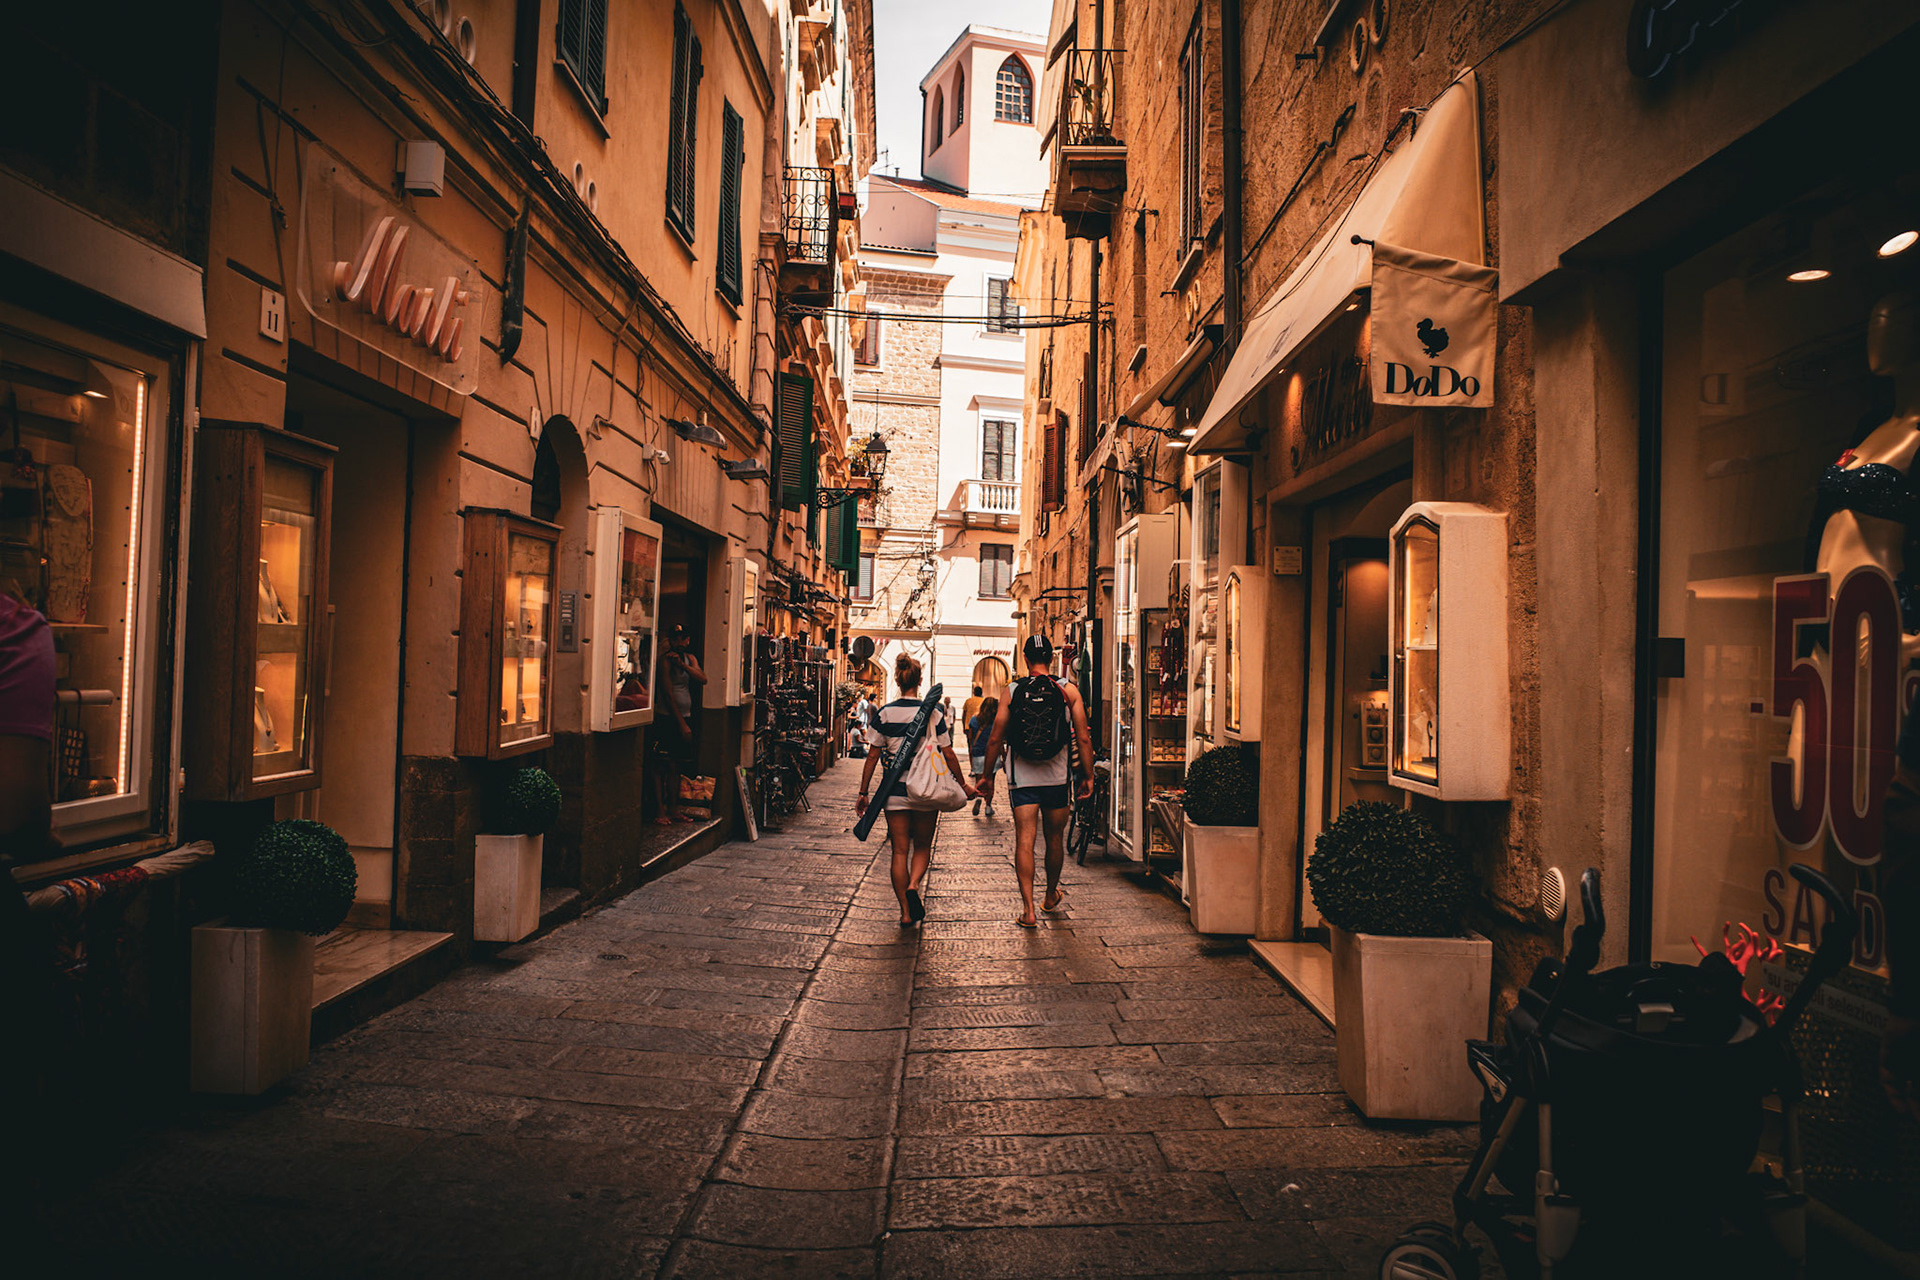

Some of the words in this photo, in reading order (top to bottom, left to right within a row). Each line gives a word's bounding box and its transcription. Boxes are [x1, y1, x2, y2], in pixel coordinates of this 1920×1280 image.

[267, 310, 278, 332] 11
[1383, 361, 1481, 398] DoDo
[1762, 868, 1885, 970] SAD
